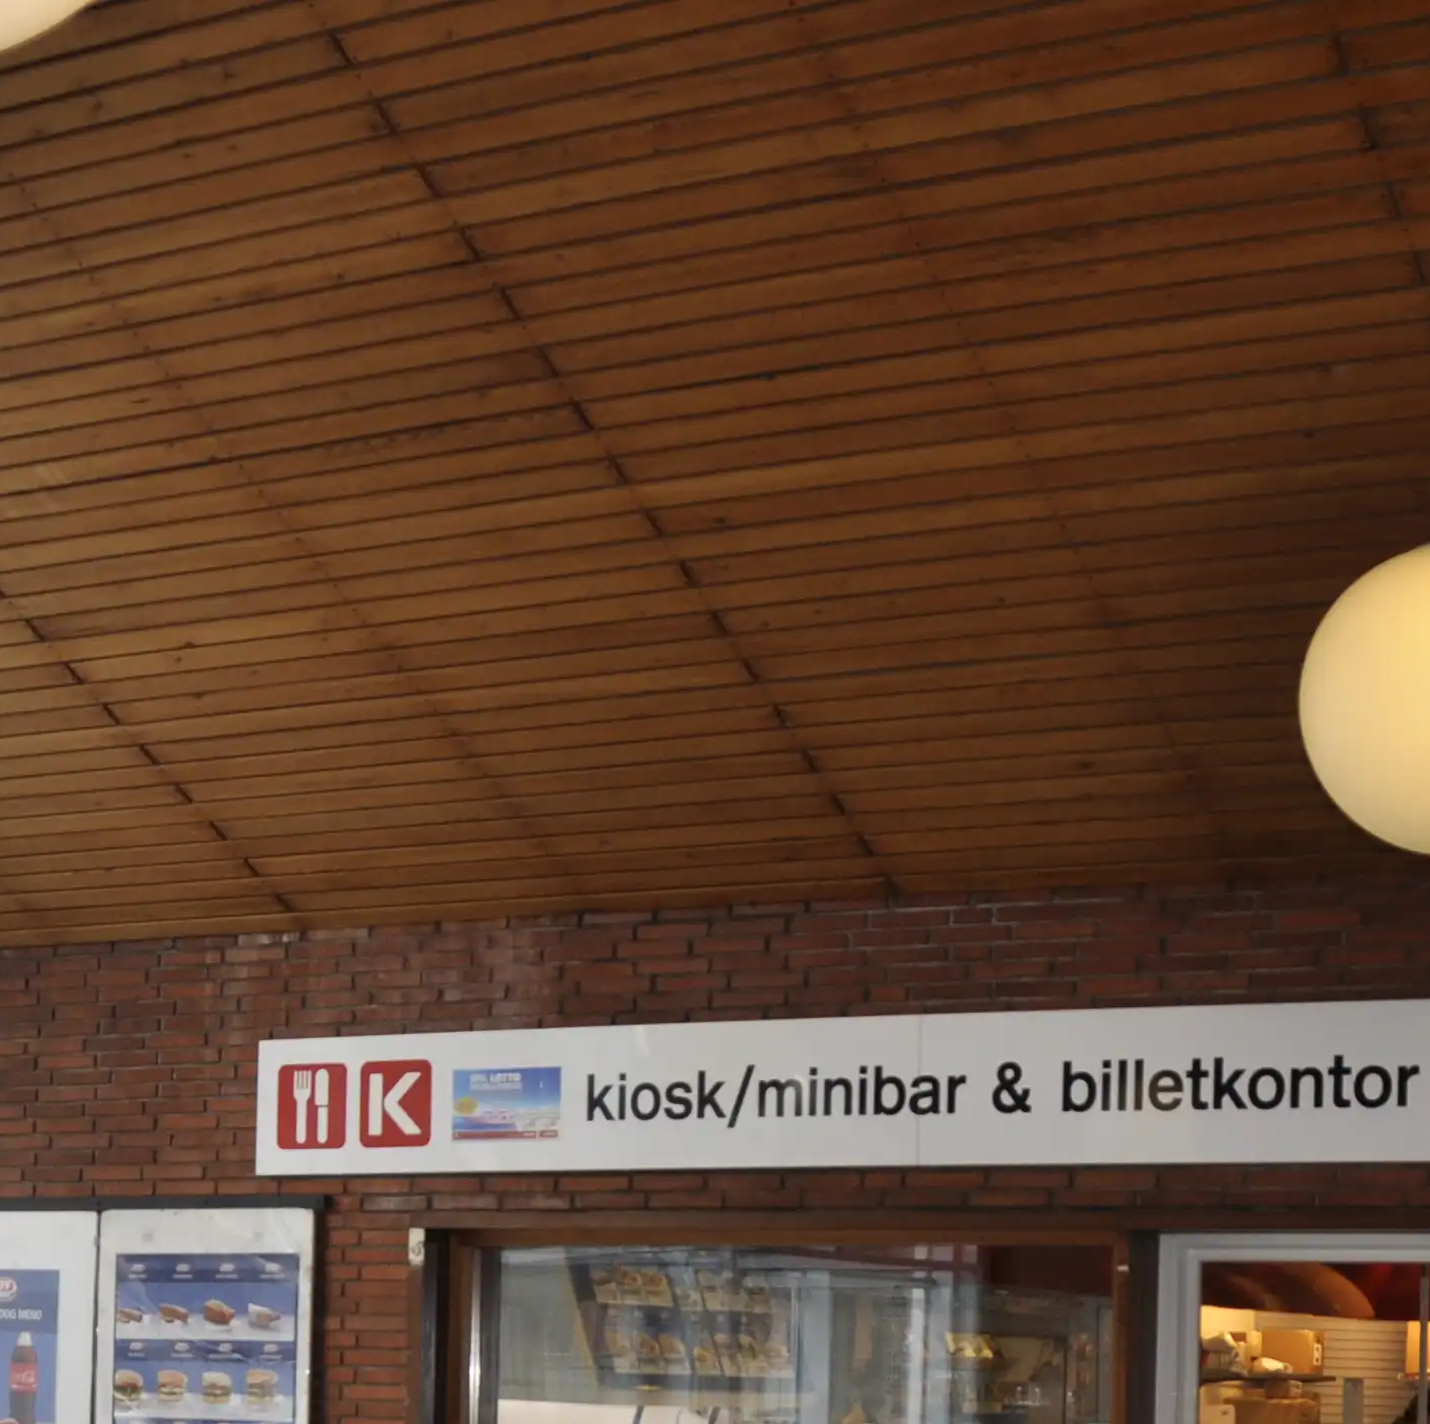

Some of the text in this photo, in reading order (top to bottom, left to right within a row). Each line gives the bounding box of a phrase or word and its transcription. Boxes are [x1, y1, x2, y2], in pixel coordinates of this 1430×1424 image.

[368, 1055, 1421, 1136] K kiosk/minibar & billetkontor
